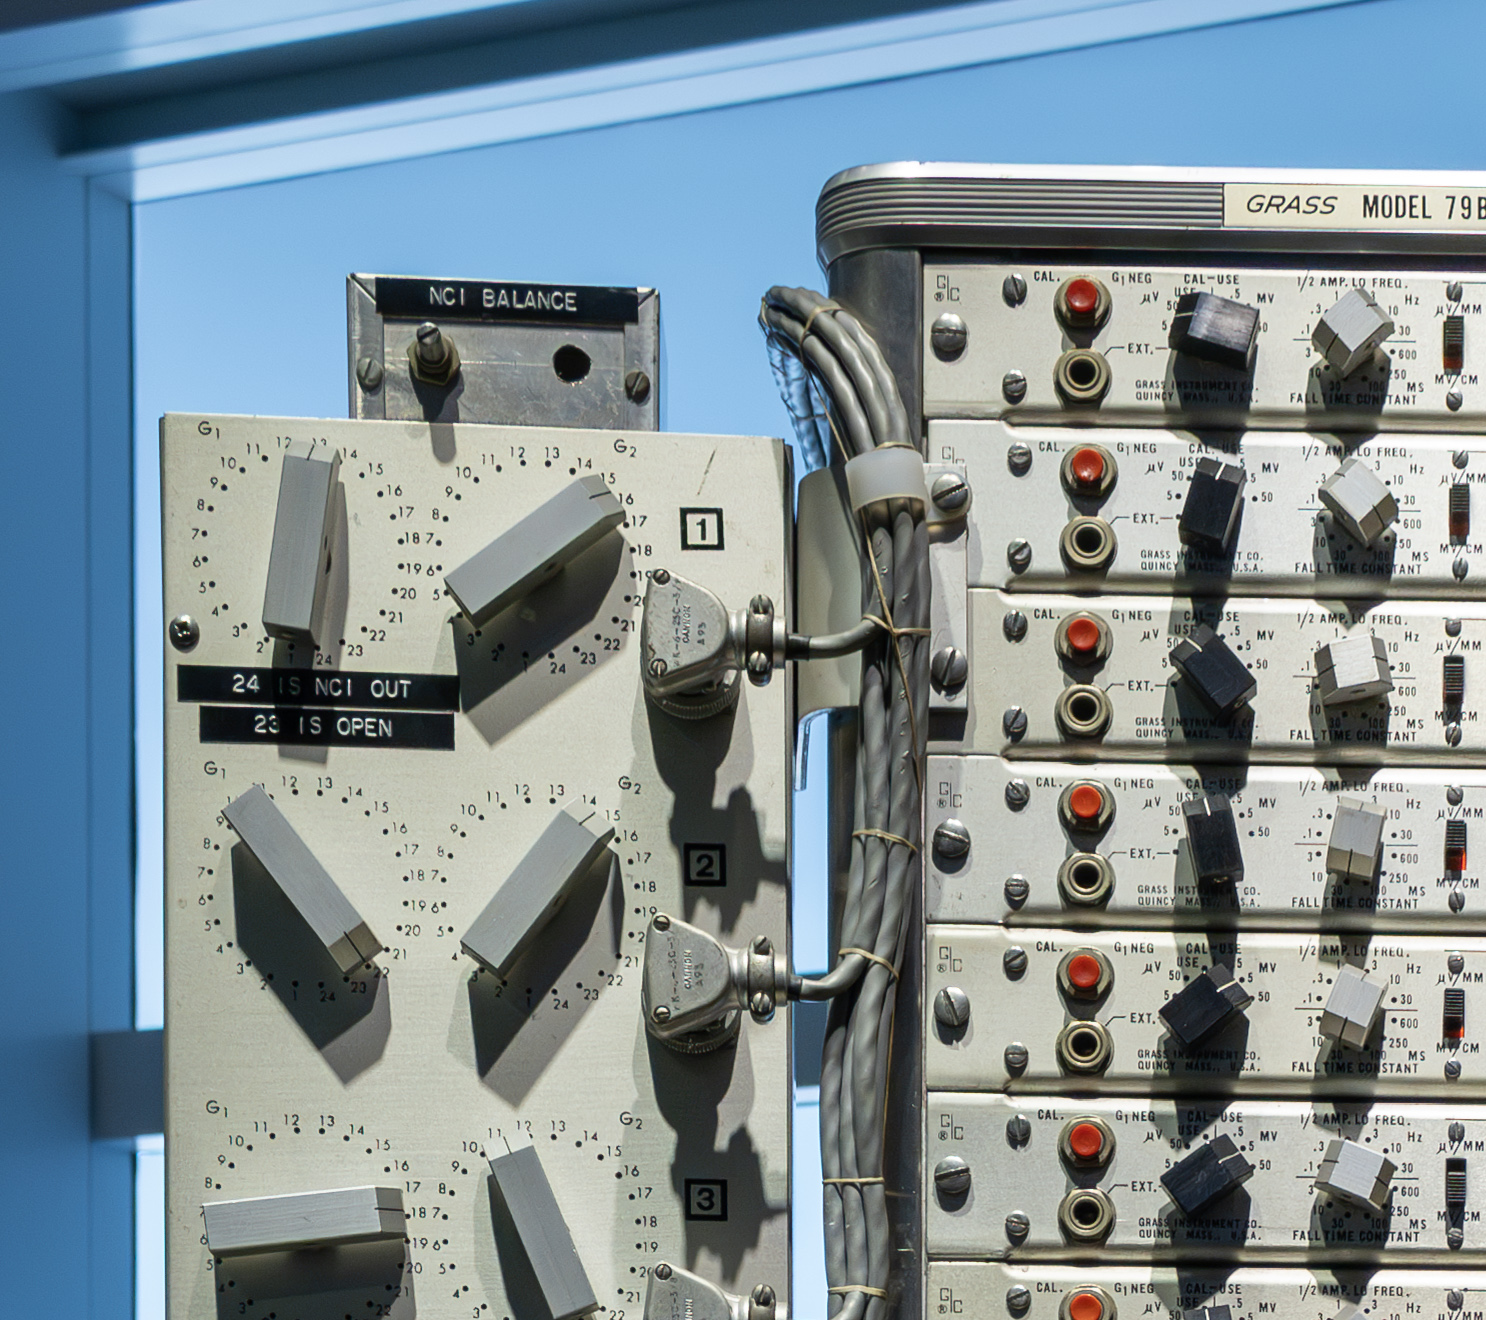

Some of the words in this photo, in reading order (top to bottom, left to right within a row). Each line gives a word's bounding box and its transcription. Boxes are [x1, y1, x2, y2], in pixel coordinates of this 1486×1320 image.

[1246, 194, 1338, 215] GRASS
[1363, 194, 1432, 220] MODEL
[428, 287, 466, 307] NCI
[482, 289, 577, 312] BALANCE
[246, 443, 261, 456] 11
[506, 445, 527, 459] 12
[220, 456, 237, 469] 10
[386, 485, 402, 497] 16
[369, 629, 386, 641] 22
[346, 642, 365, 657] 23
[231, 675, 260, 692] 24
[313, 676, 353, 697] NCI
[370, 679, 412, 699] OUT
[252, 713, 281, 735] 23
[336, 717, 393, 737] OPEN
